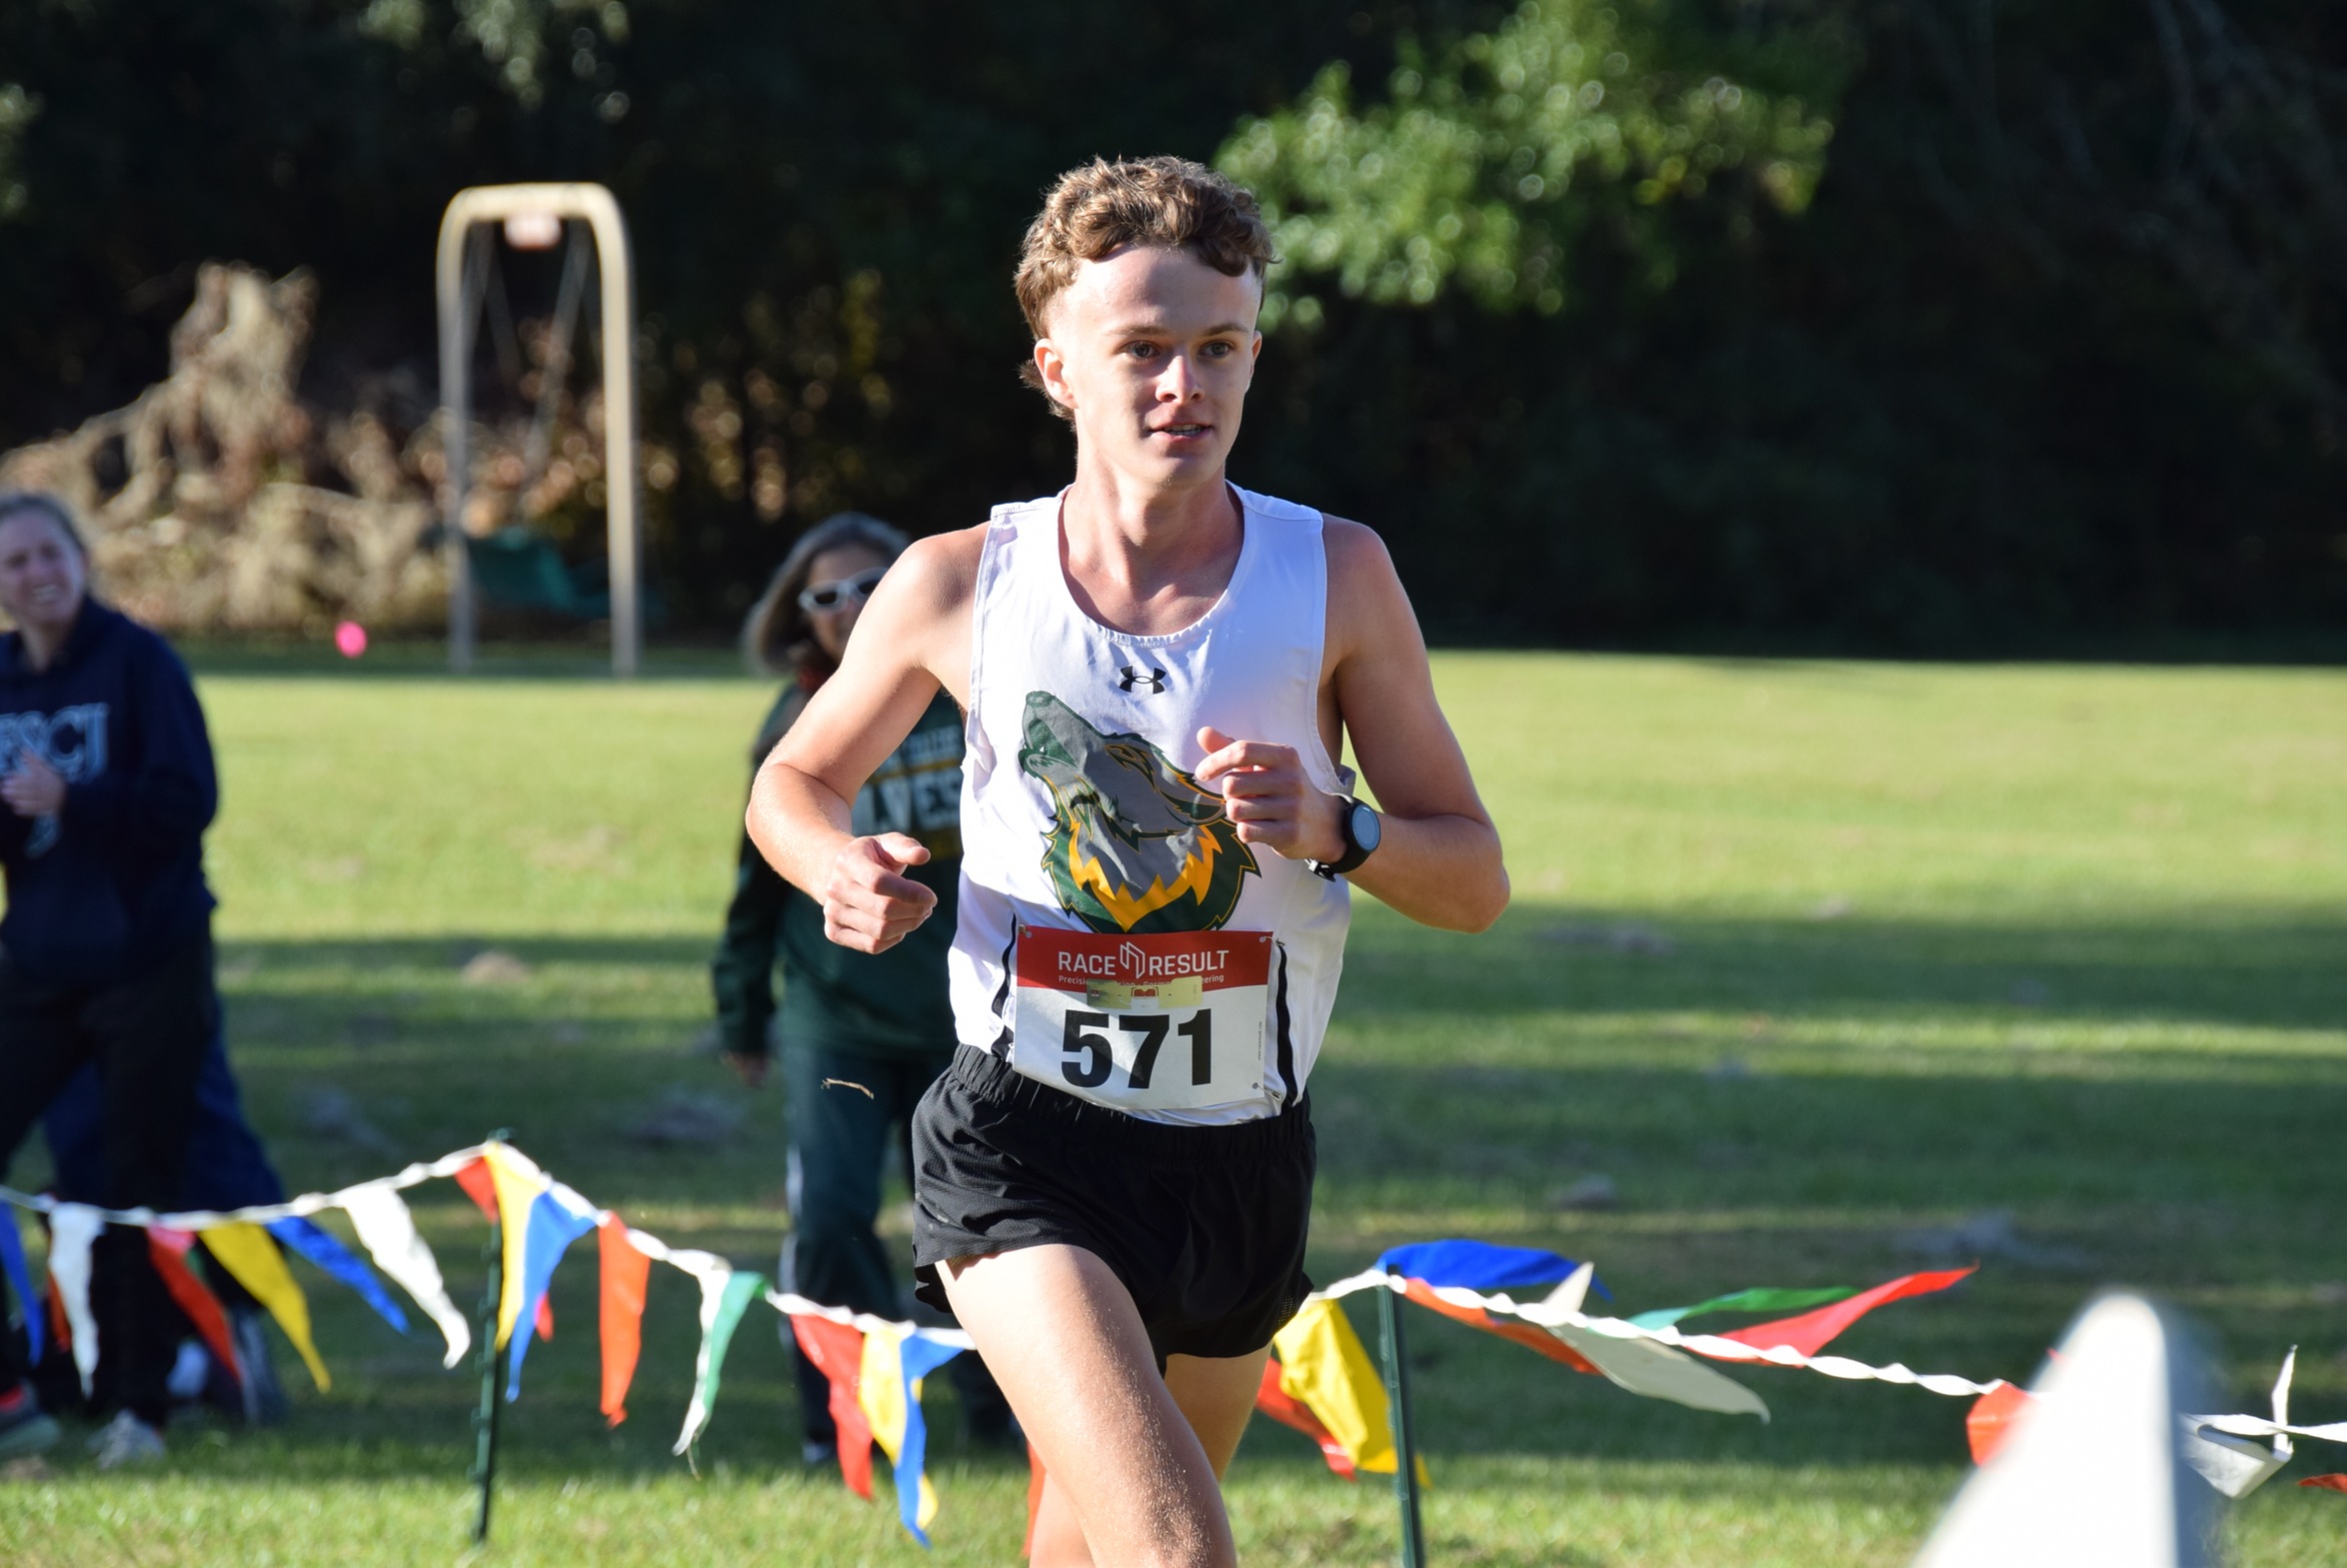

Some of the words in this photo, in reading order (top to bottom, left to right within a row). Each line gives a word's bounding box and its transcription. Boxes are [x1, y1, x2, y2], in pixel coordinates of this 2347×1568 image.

[1059, 951, 1117, 975] RACE
[1149, 950, 1229, 976] RESULT
[1061, 1008, 1212, 1089] 571
